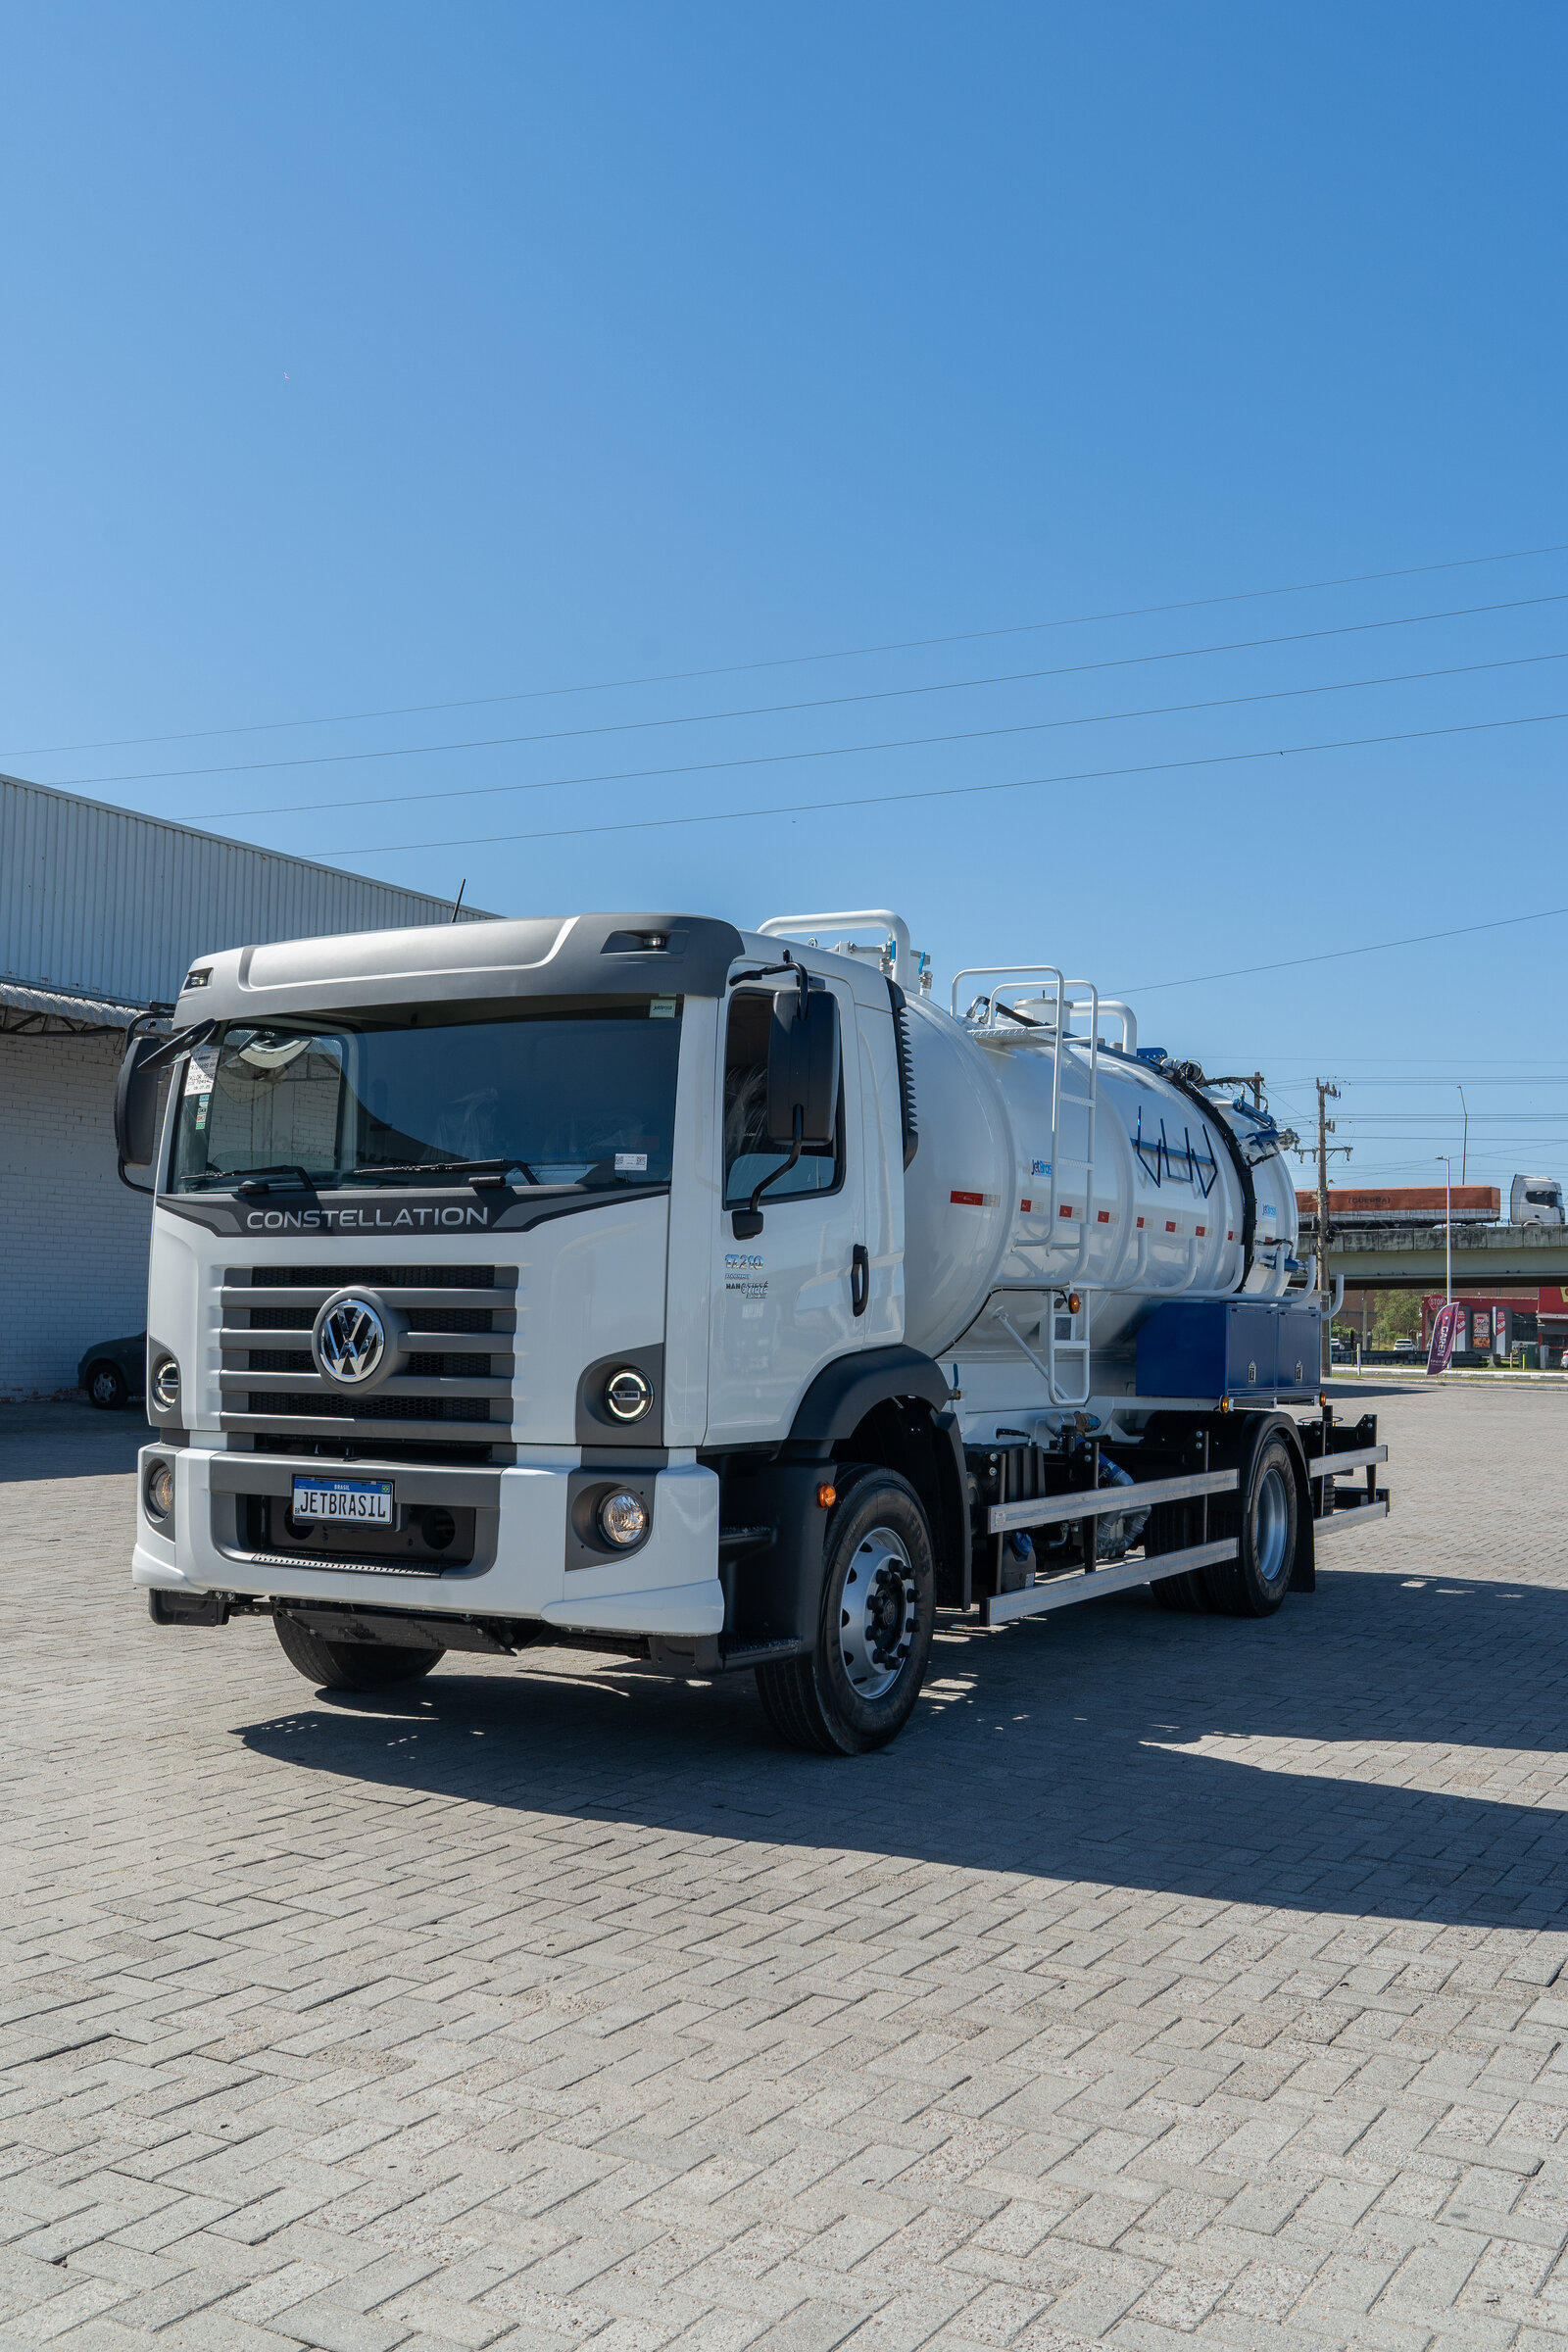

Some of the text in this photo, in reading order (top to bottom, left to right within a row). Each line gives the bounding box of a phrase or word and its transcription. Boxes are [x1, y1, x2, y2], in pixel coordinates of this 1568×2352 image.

[246, 1206, 488, 1230] CONSTELLATION
[724, 1253, 763, 1270] 17.210
[1437, 1326, 1448, 1356] GAREN
[300, 1492, 386, 1518] JETBRASIL
